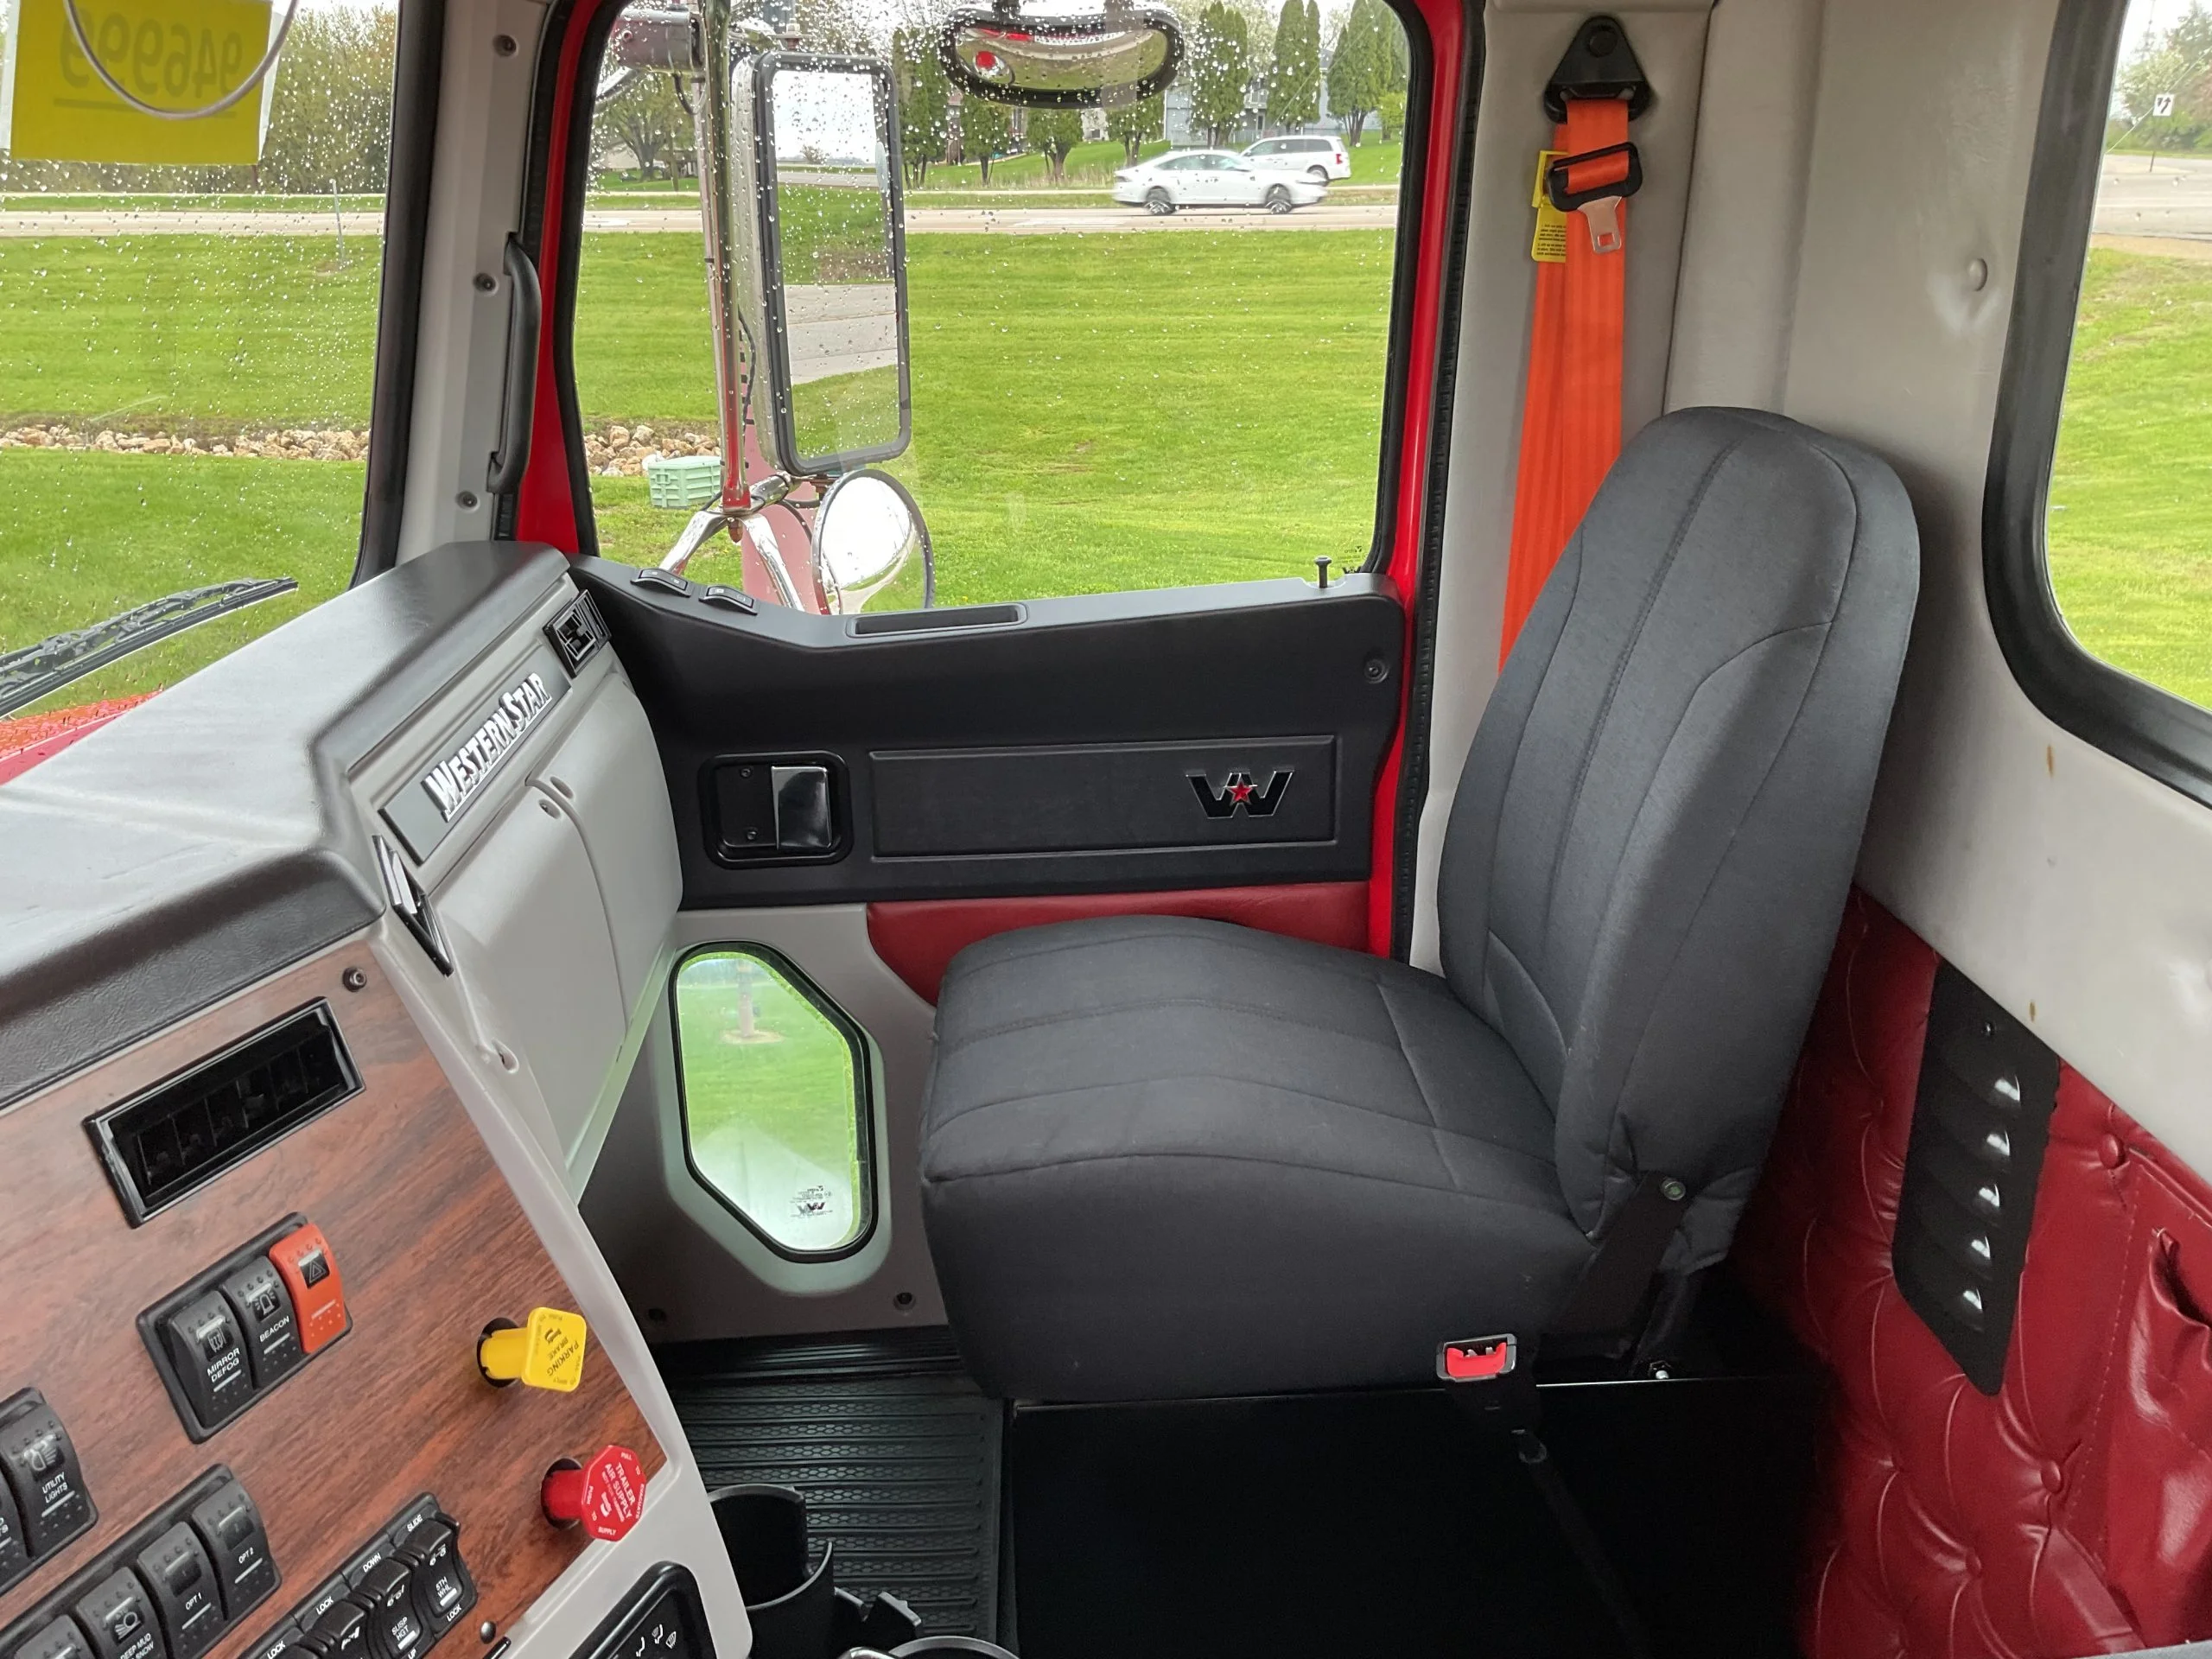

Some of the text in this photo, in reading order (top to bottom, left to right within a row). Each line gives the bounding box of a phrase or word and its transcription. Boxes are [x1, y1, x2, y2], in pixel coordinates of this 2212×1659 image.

[259, 1315, 289, 1342] BEACON
[547, 1340, 579, 1376] PARKING
[548, 1337, 568, 1360] BRAKE
[207, 1348, 240, 1376] MIRROR
[211, 1357, 239, 1382] DEFOG
[42, 1471, 65, 1493] UTILITY
[605, 1464, 616, 1481] AIR
[613, 1480, 632, 1518] SUPPLY
[616, 1462, 635, 1505] TRAILER
[45, 1482, 68, 1503] LIGHTS
[407, 1514, 423, 1532] SLIDE
[238, 1549, 250, 1564] OPT
[362, 1553, 381, 1573] DOWN
[435, 1576, 448, 1591] 5TH
[437, 1583, 453, 1598] WHL
[186, 1594, 198, 1610] OPT
[315, 1596, 334, 1615] LOCK
[446, 1604, 462, 1622] LOCK
[391, 1616, 408, 1635] SUSP
[397, 1624, 410, 1641] HGT
[267, 1640, 286, 1659] LOCK
